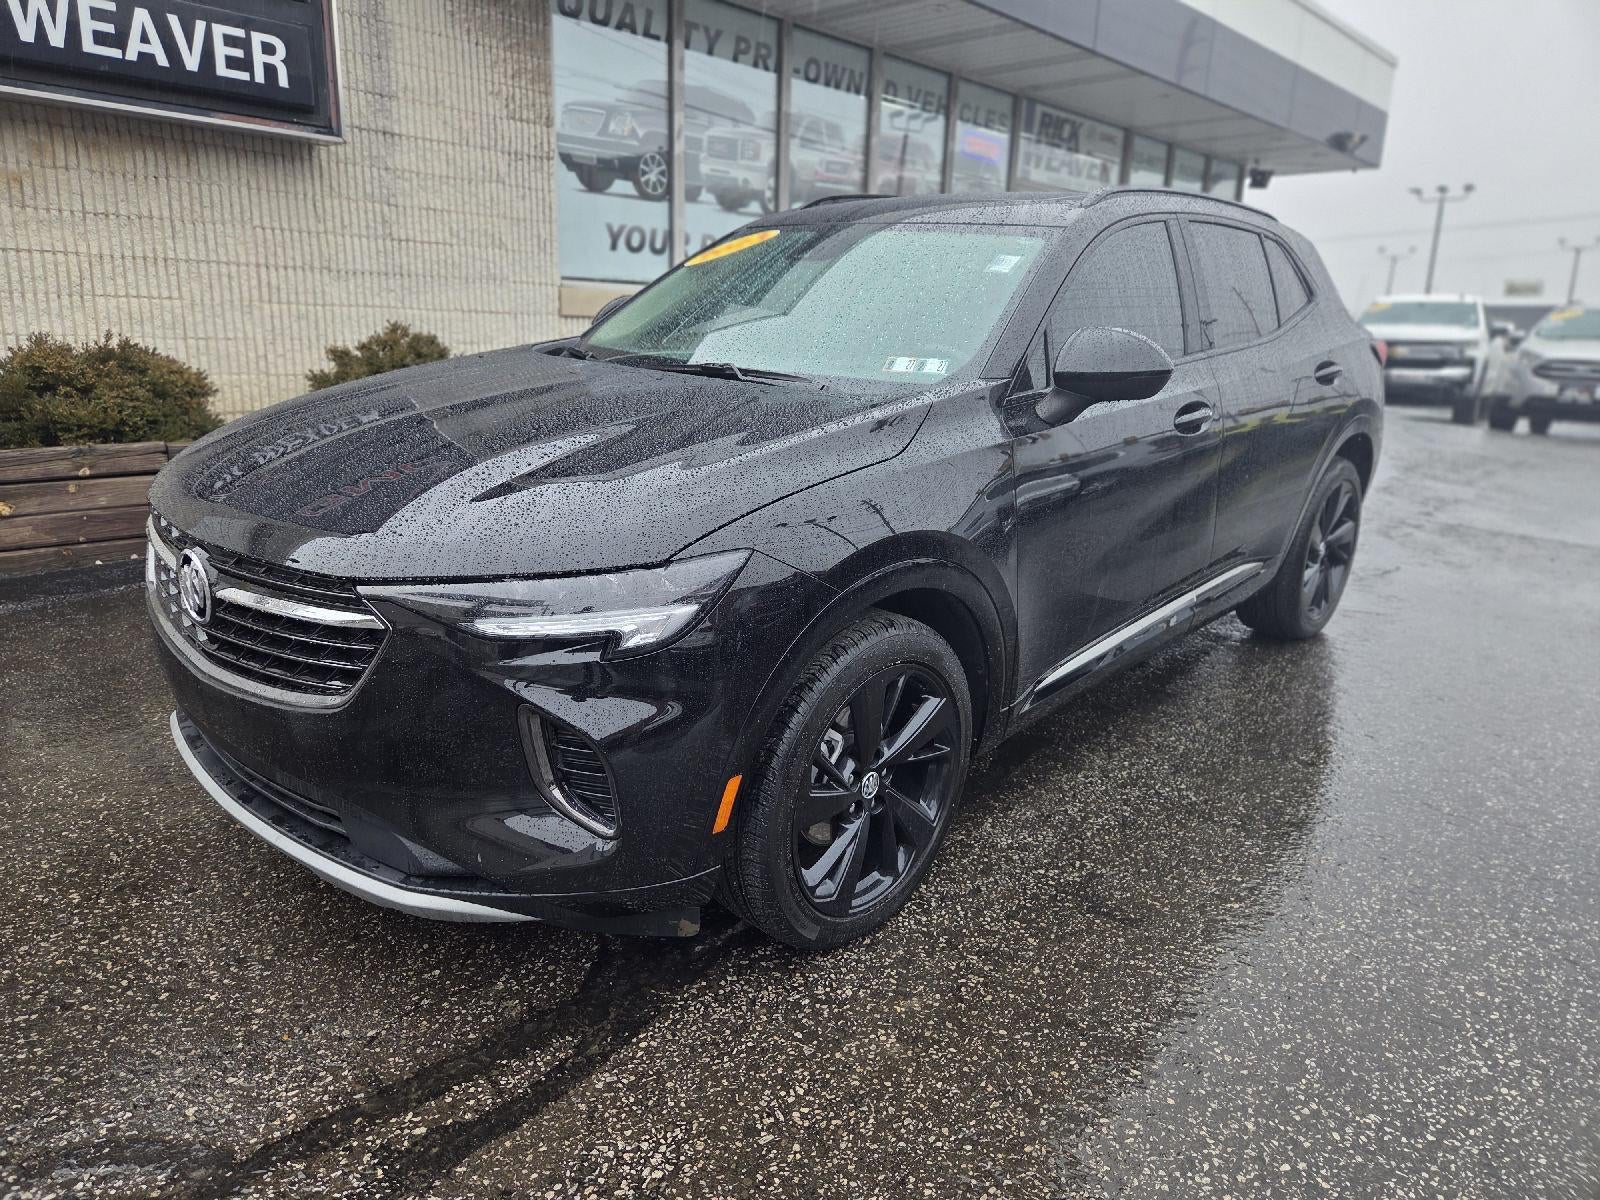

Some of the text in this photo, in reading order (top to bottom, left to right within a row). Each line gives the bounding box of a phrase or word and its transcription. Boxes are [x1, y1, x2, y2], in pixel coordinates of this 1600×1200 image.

[5, 0, 290, 89] WEAVER
[556, 0, 723, 56] QUALTY
[906, 84, 1009, 134] VEHCLES
